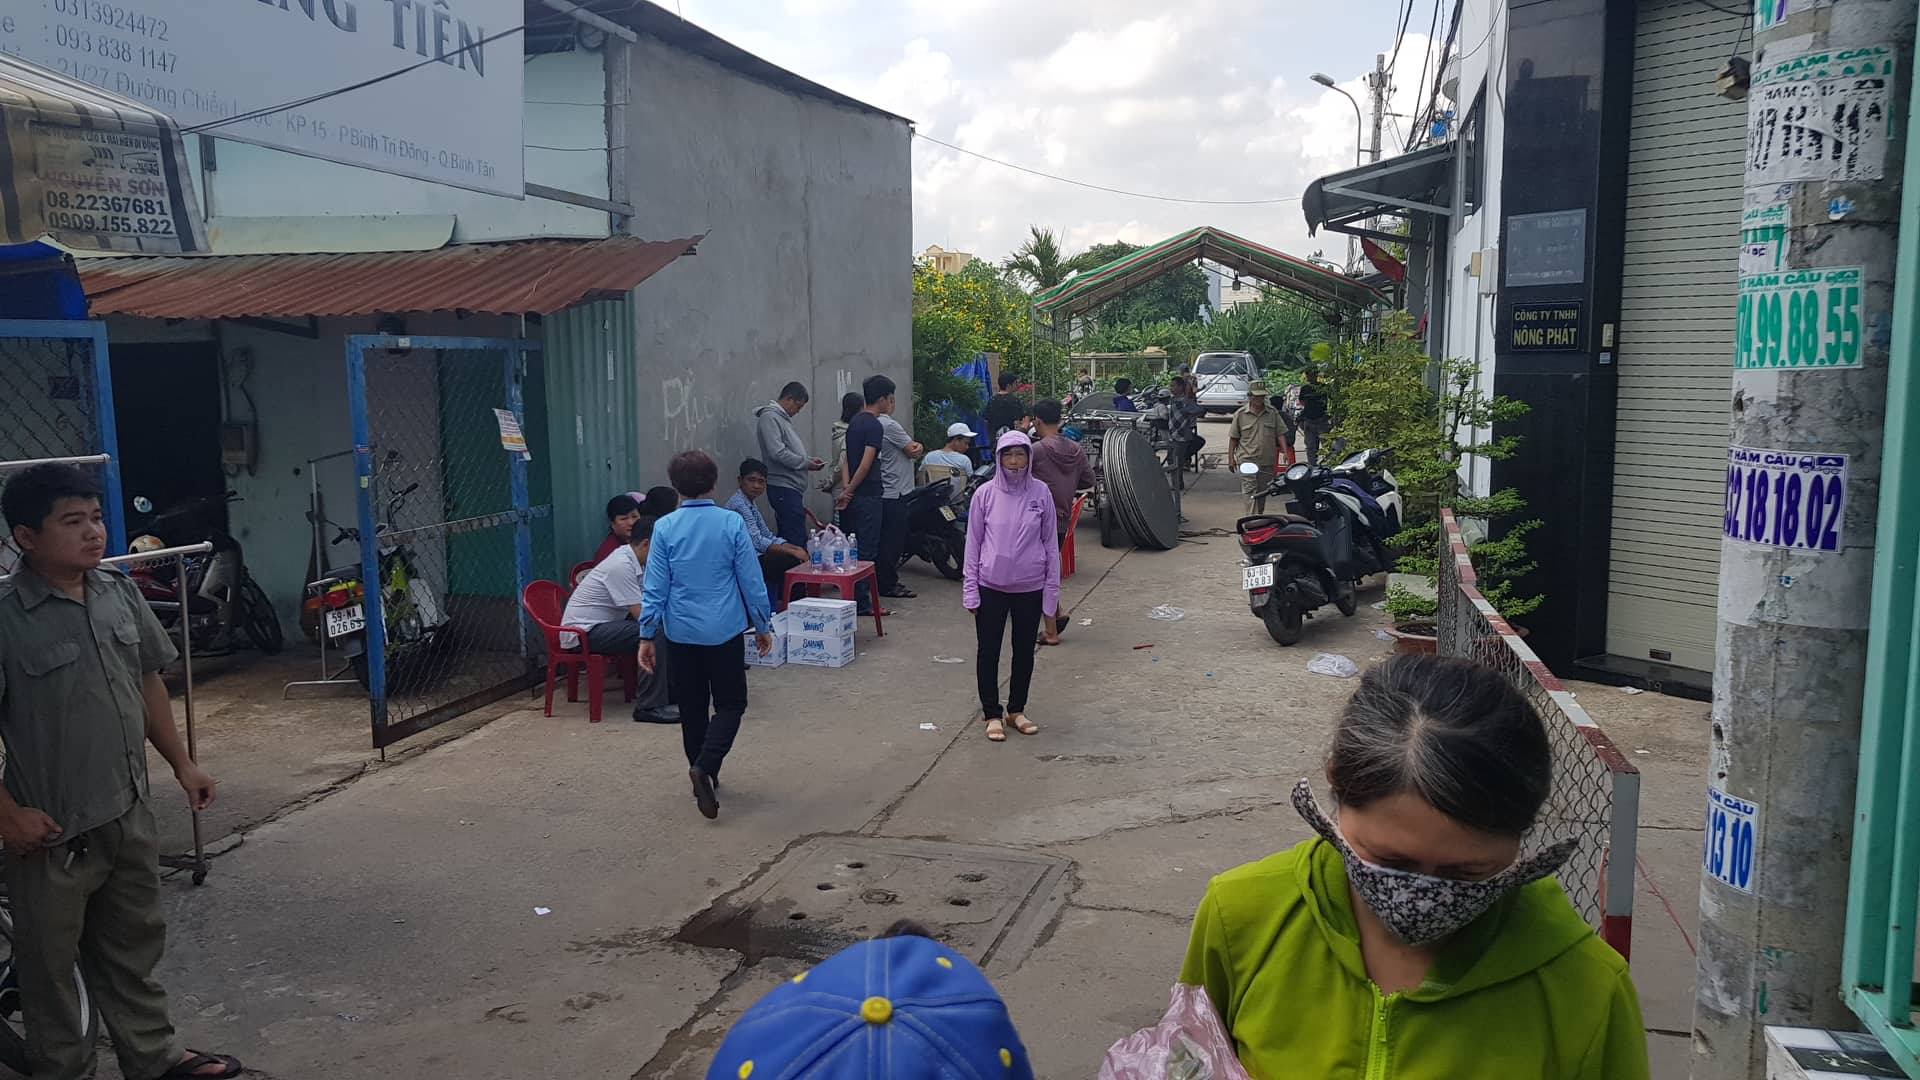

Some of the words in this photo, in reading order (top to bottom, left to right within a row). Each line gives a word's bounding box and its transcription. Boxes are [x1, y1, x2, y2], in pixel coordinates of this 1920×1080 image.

[55, 0, 169, 42] 0313924472
[56, 24, 92, 52] 093
[99, 35, 132, 62] 838
[138, 45, 178, 74] 1147
[46, 190, 168, 216] 08.22367681
[48, 212, 174, 235] 0909.155.822
[1514, 308, 1538, 321] CÔNG
[1540, 310, 1552, 320] TY
[1554, 309, 1577, 320] TNHH
[1513, 323, 1544, 346] NÔNG
[1546, 323, 1577, 345] PHÁT
